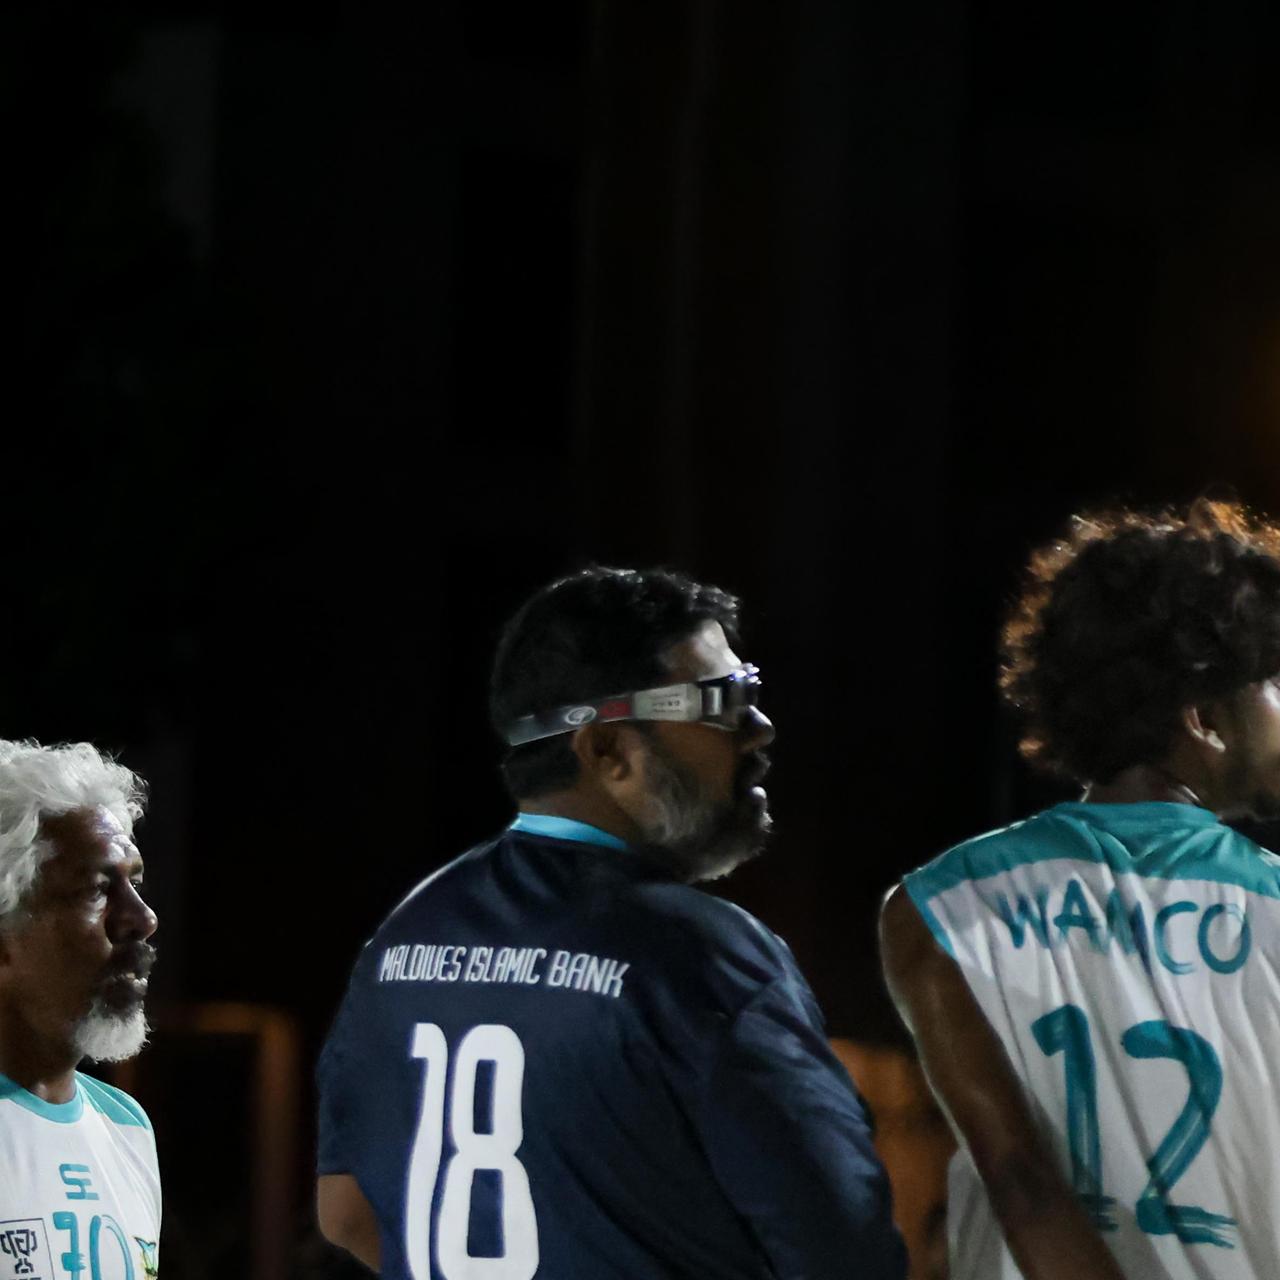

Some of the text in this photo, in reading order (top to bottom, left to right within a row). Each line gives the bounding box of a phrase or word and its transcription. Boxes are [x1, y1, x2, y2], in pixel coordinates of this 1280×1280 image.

[379, 943, 630, 998] MALDIVES ISLAMIC BANK
[1031, 1003, 1238, 1250] 12
